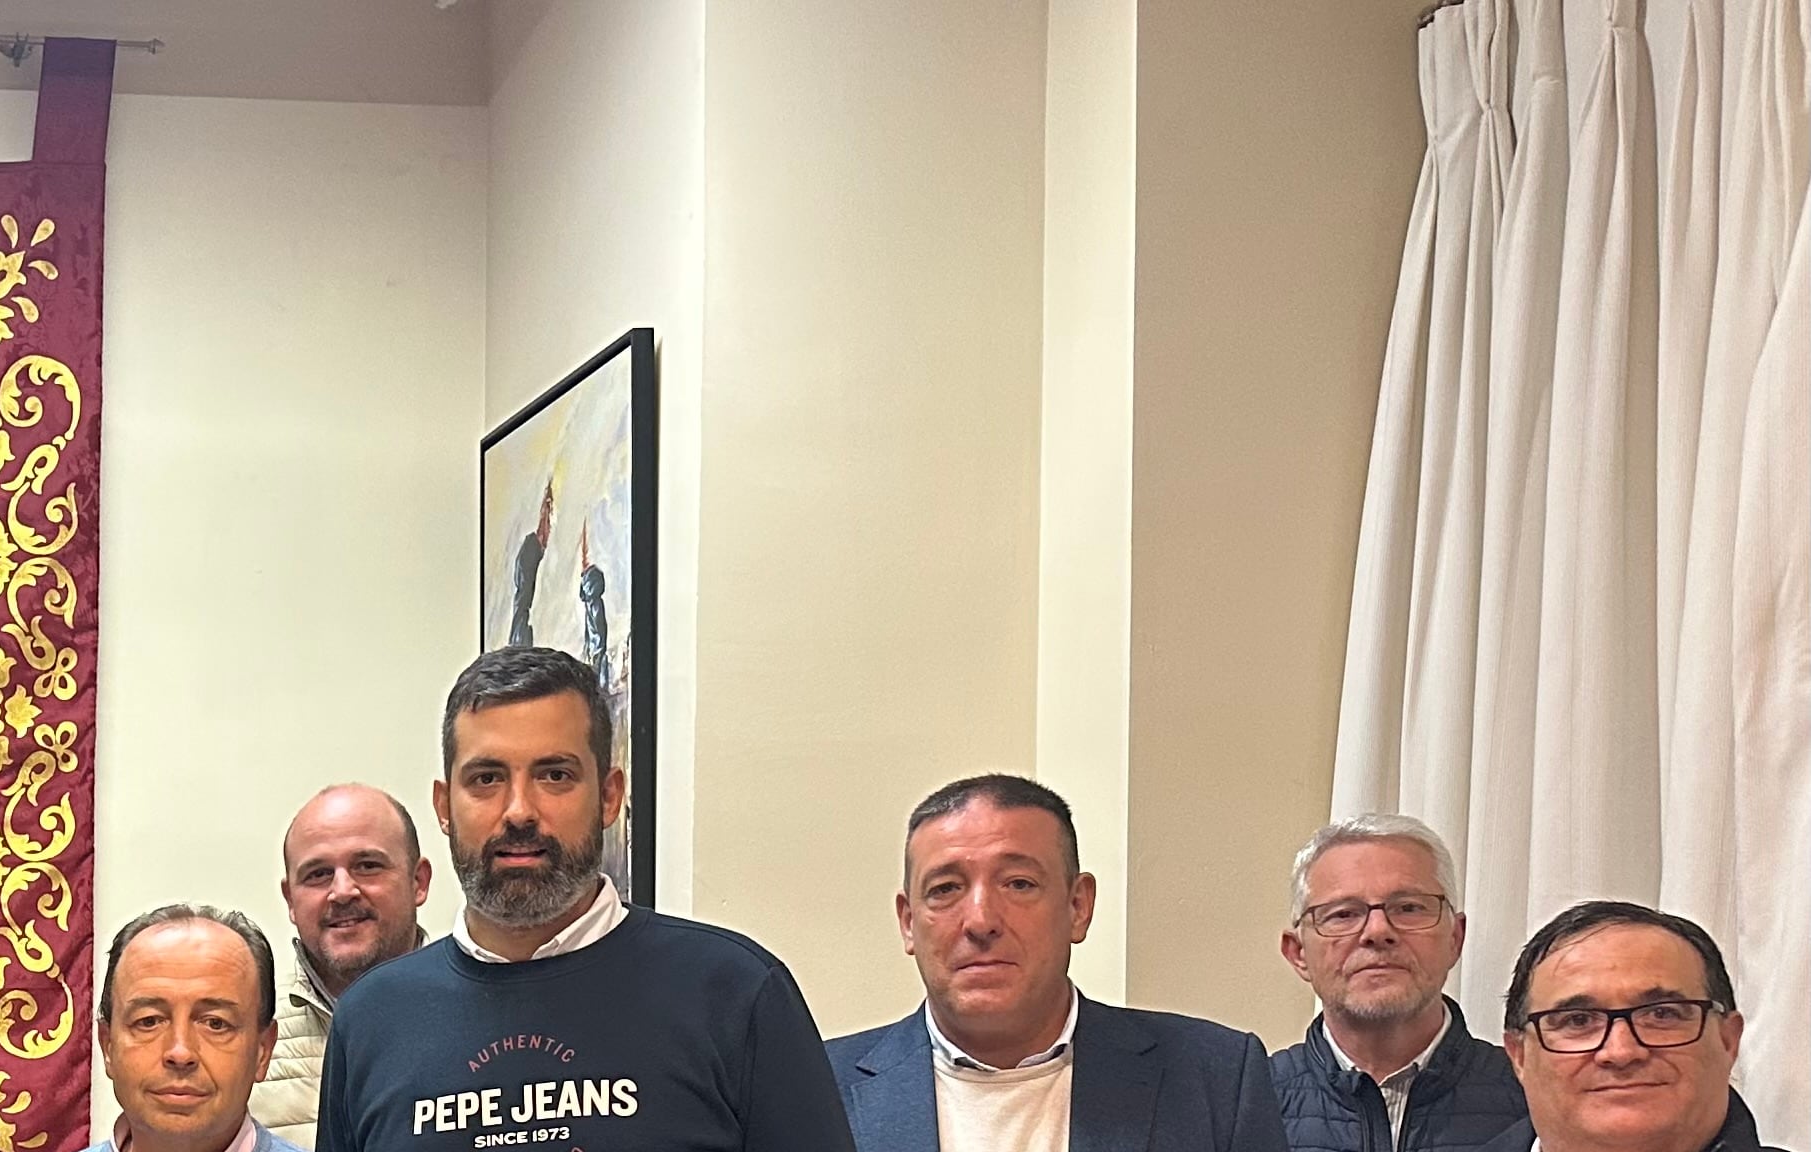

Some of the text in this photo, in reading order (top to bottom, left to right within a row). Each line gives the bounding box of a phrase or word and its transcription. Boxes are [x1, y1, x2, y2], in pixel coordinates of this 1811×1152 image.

[467, 1034, 576, 1073] AUTHENTIC
[412, 1079, 638, 1135] PEPE JEANS
[474, 1126, 570, 1149] SINCE 1973
